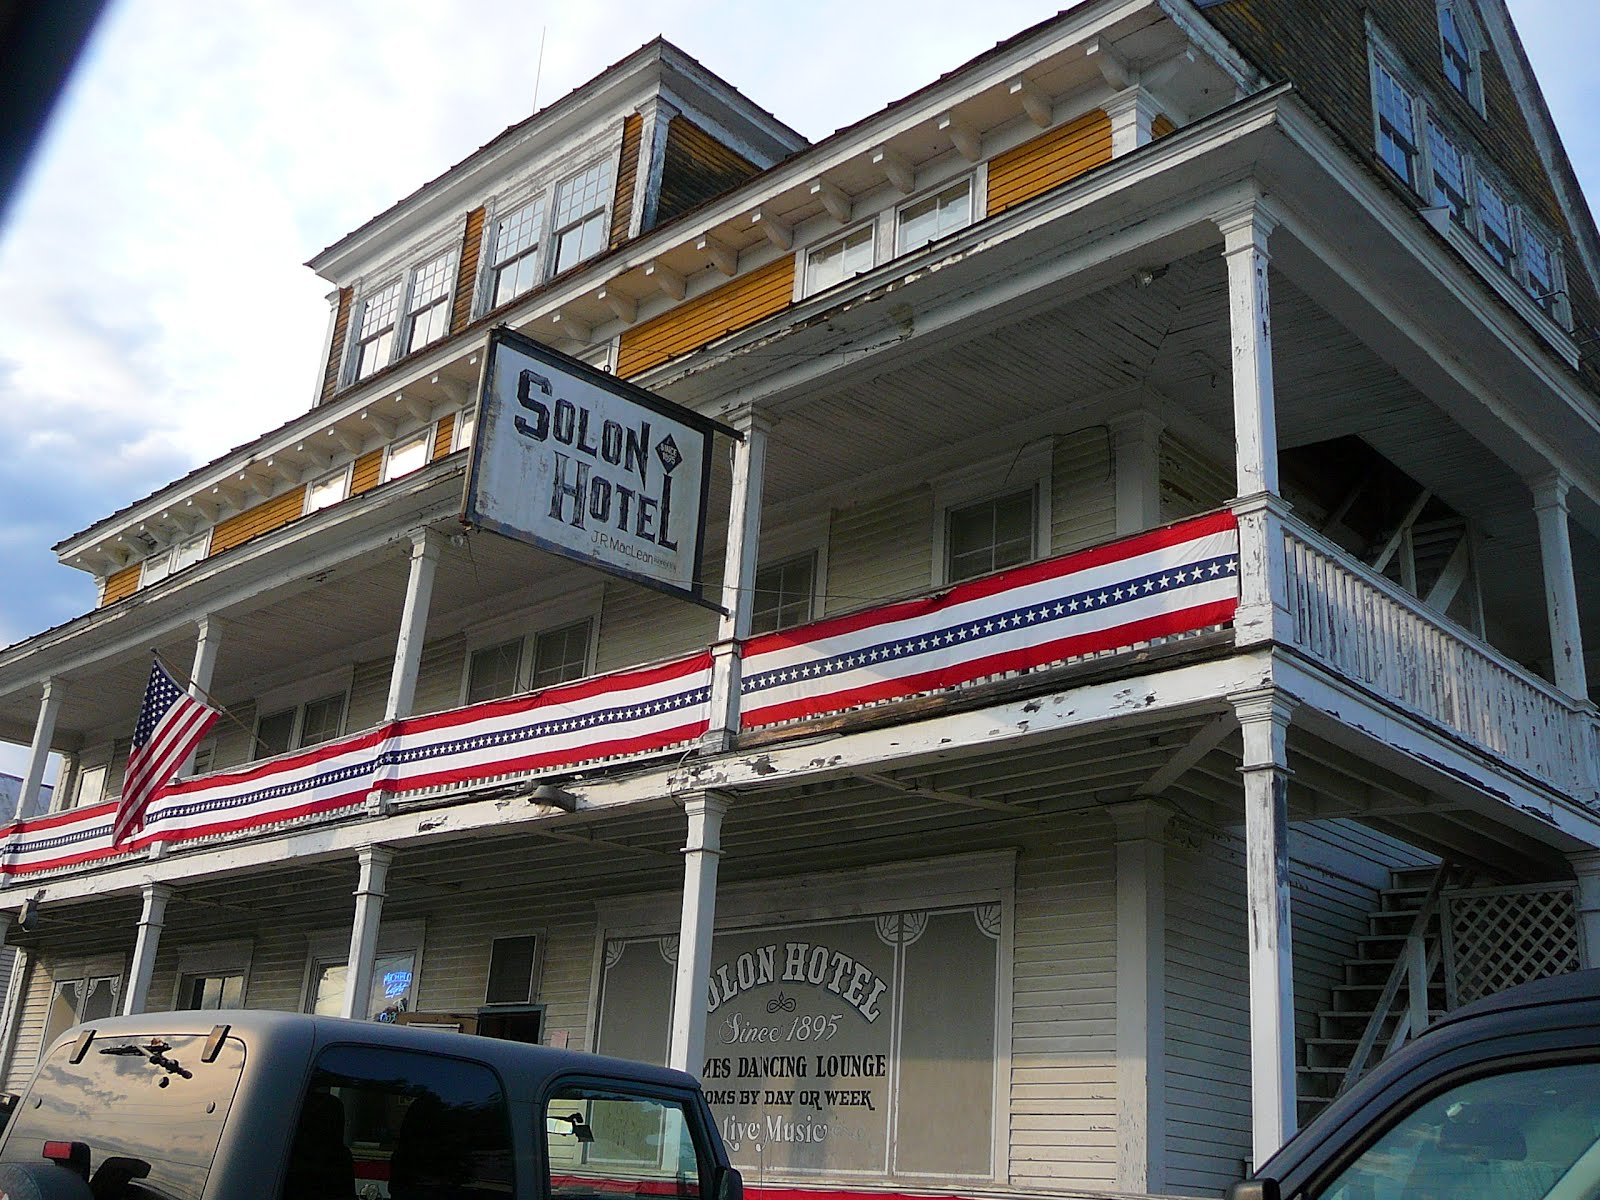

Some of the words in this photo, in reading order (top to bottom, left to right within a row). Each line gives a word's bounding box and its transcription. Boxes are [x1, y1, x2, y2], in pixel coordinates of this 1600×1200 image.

[514, 368, 652, 491] SOLON
[548, 451, 678, 552] HOTEL
[707, 944, 777, 1013] OLON
[782, 942, 888, 1023] HOTEL
[719, 1012, 783, 1044] Since
[786, 1014, 843, 1042] 1895
[703, 1056, 731, 1079] MES
[737, 1055, 808, 1078] DANCING
[816, 1054, 886, 1077] LOUNGE
[704, 1090, 735, 1105] OMS
[739, 1090, 760, 1105] BY
[764, 1090, 795, 1105] DAY
[799, 1090, 822, 1110] OR
[824, 1090, 875, 1110] WEEK
[722, 1115, 761, 1151] Live
[756, 1114, 828, 1152] Music
